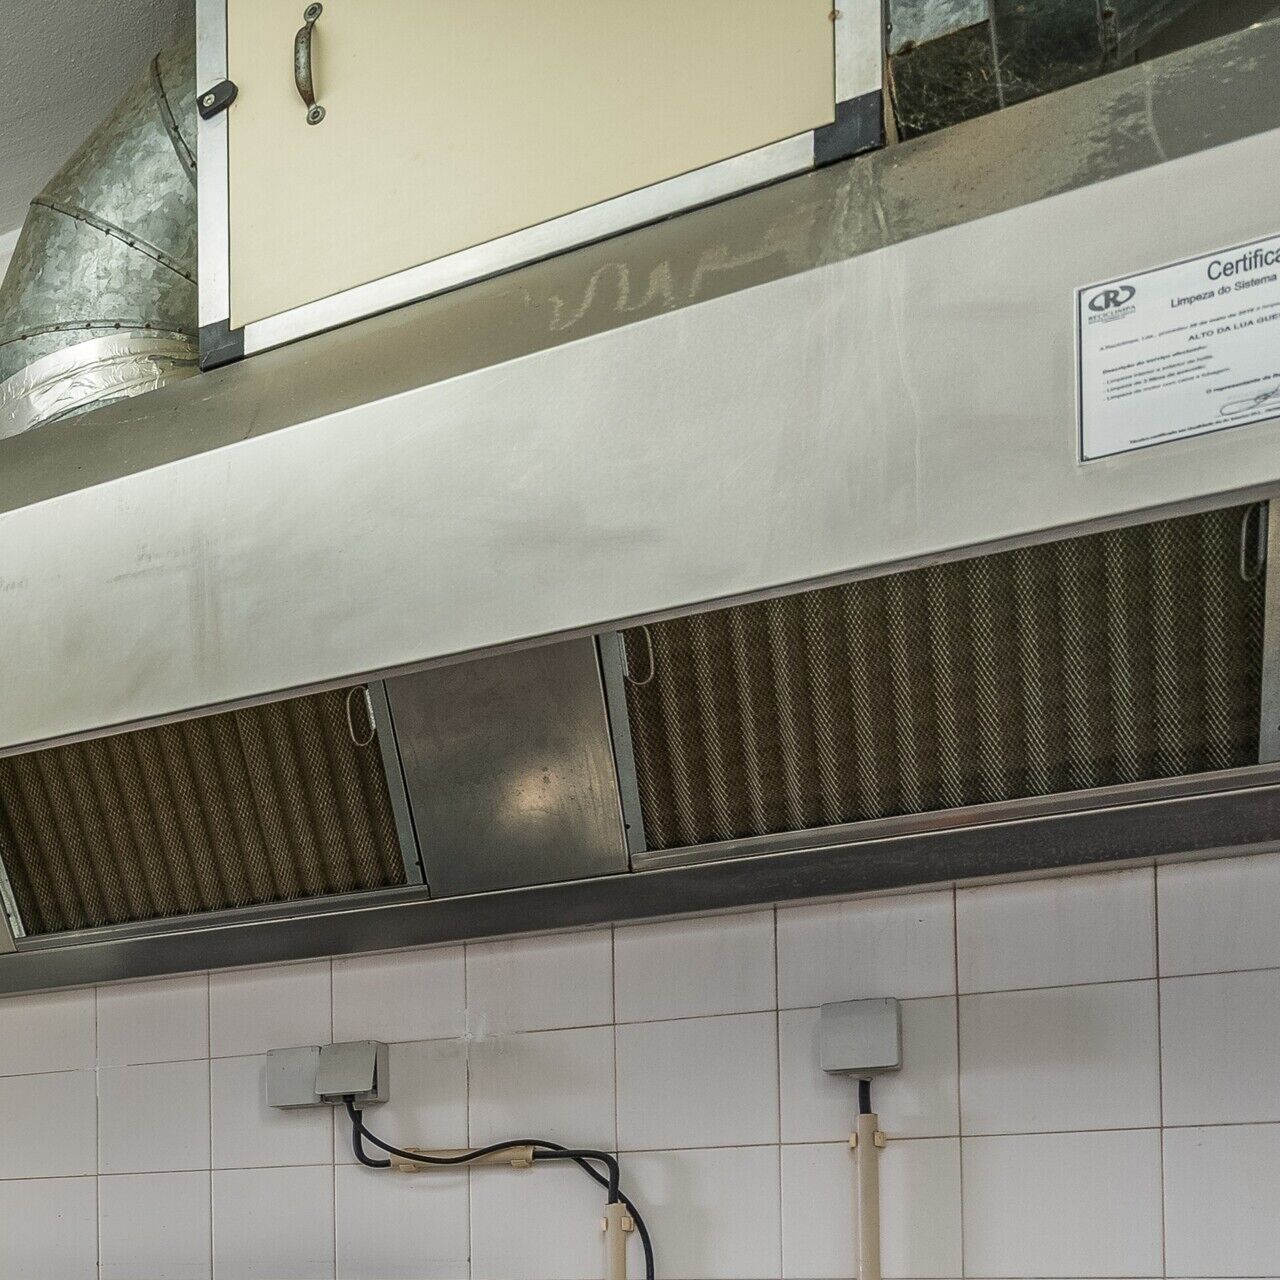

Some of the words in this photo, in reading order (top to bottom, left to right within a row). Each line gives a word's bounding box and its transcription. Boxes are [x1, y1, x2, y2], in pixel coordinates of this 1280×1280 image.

[1170, 290, 1215, 308] Limpeza
[1217, 285, 1231, 296] do
[1234, 273, 1278, 291] Sistema
[1188, 330, 1214, 341] ALTO
[1216, 326, 1231, 334] DA
[1233, 320, 1254, 330] LUA
[1256, 312, 1280, 324] GUE
